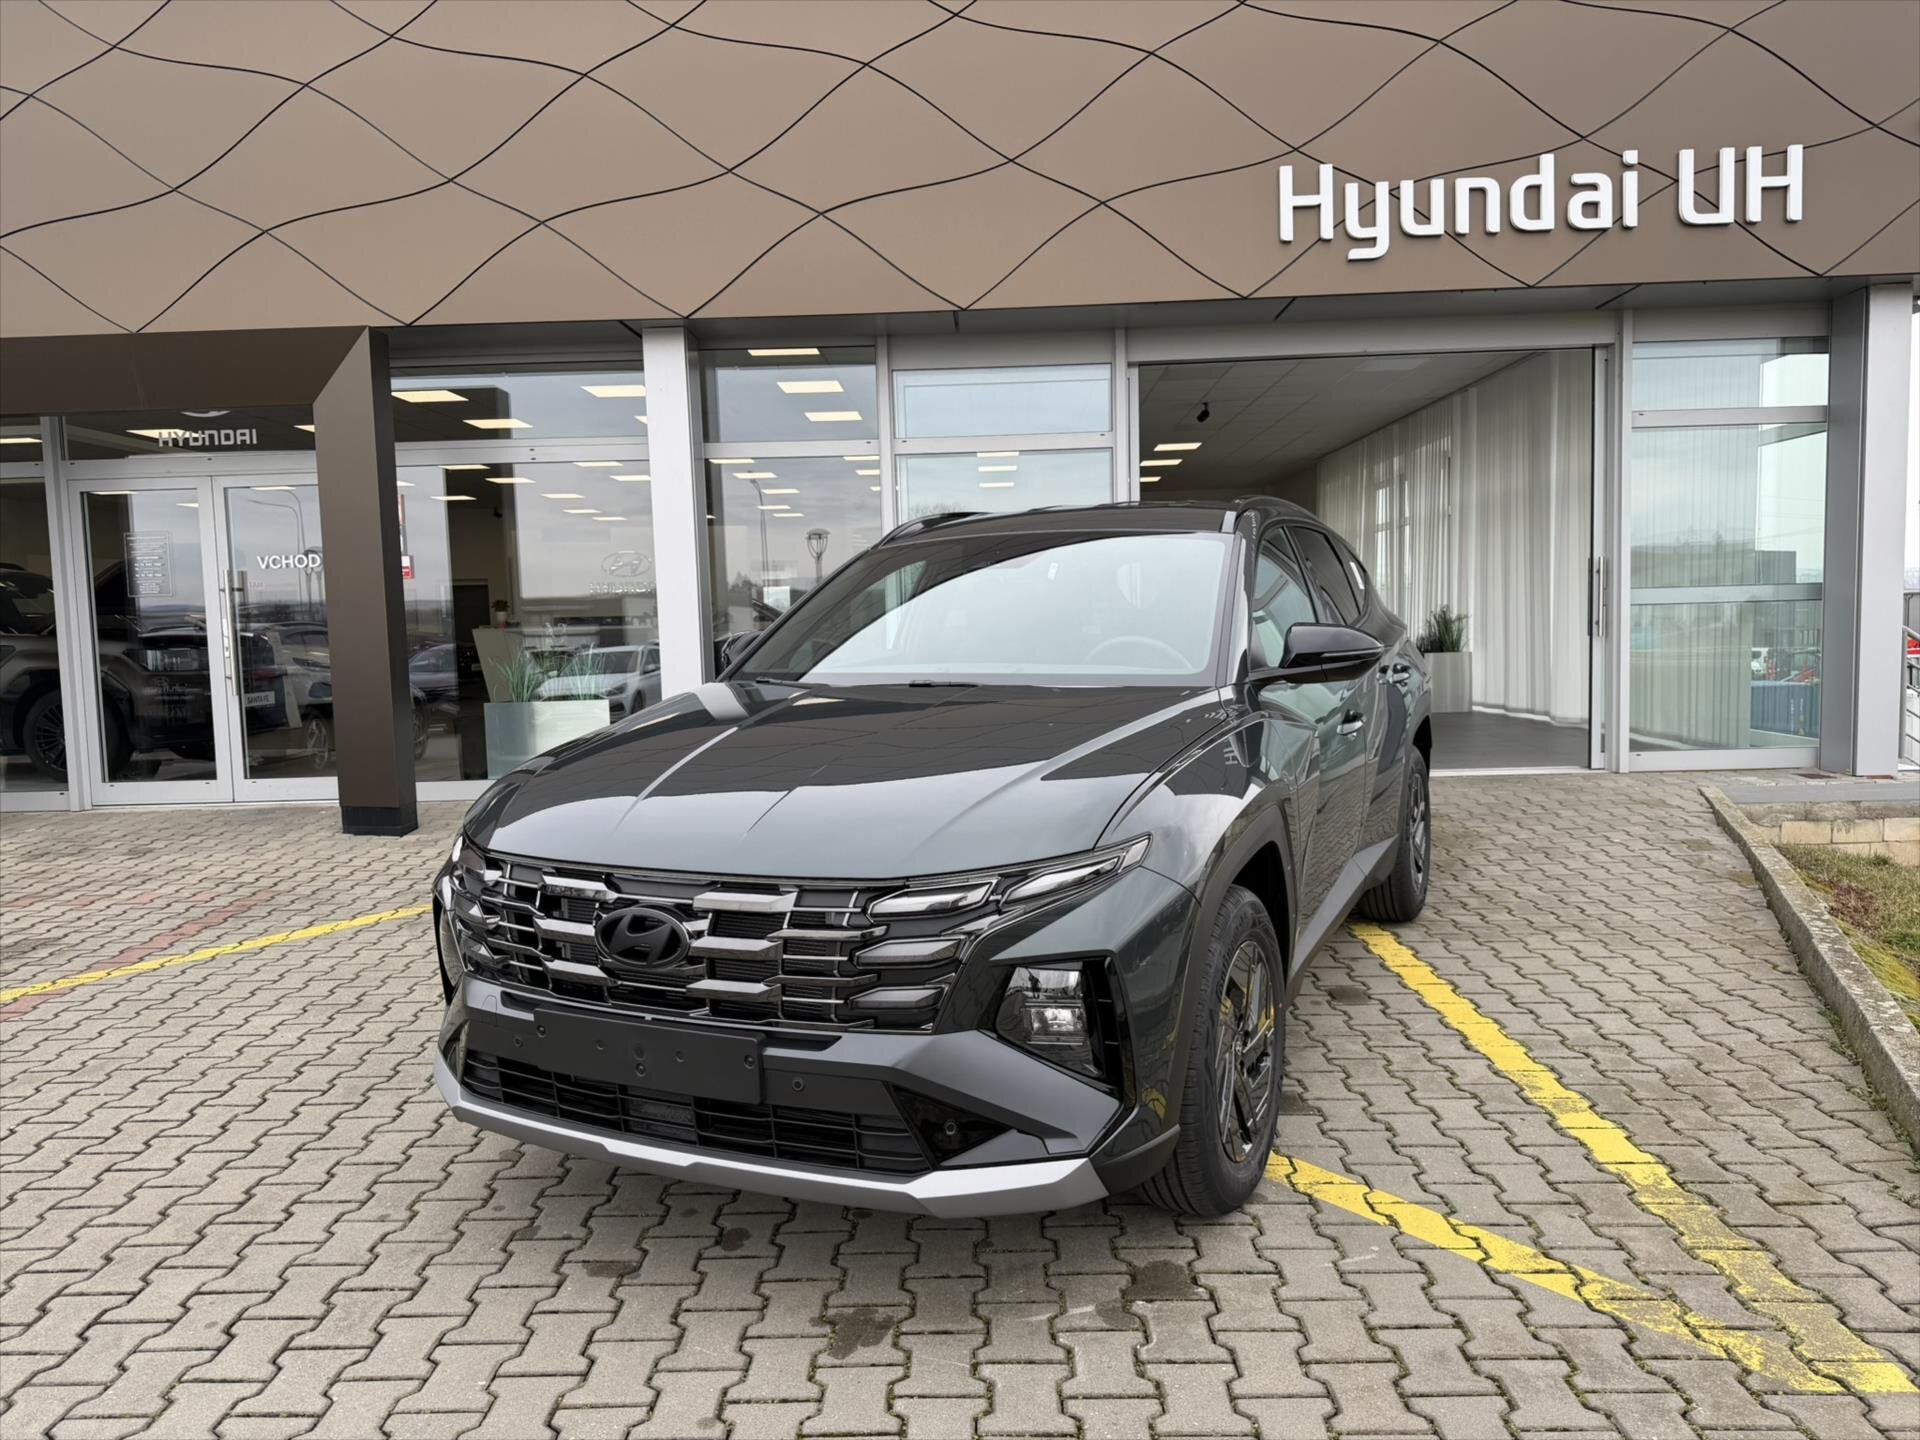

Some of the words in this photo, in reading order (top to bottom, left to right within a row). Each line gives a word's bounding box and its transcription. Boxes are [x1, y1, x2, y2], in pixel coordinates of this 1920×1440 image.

[1278, 149, 1639, 261] Hyundai
[1677, 143, 1804, 226] UH
[158, 428, 258, 447] HYUNDAI
[256, 553, 321, 569] VCHOD
